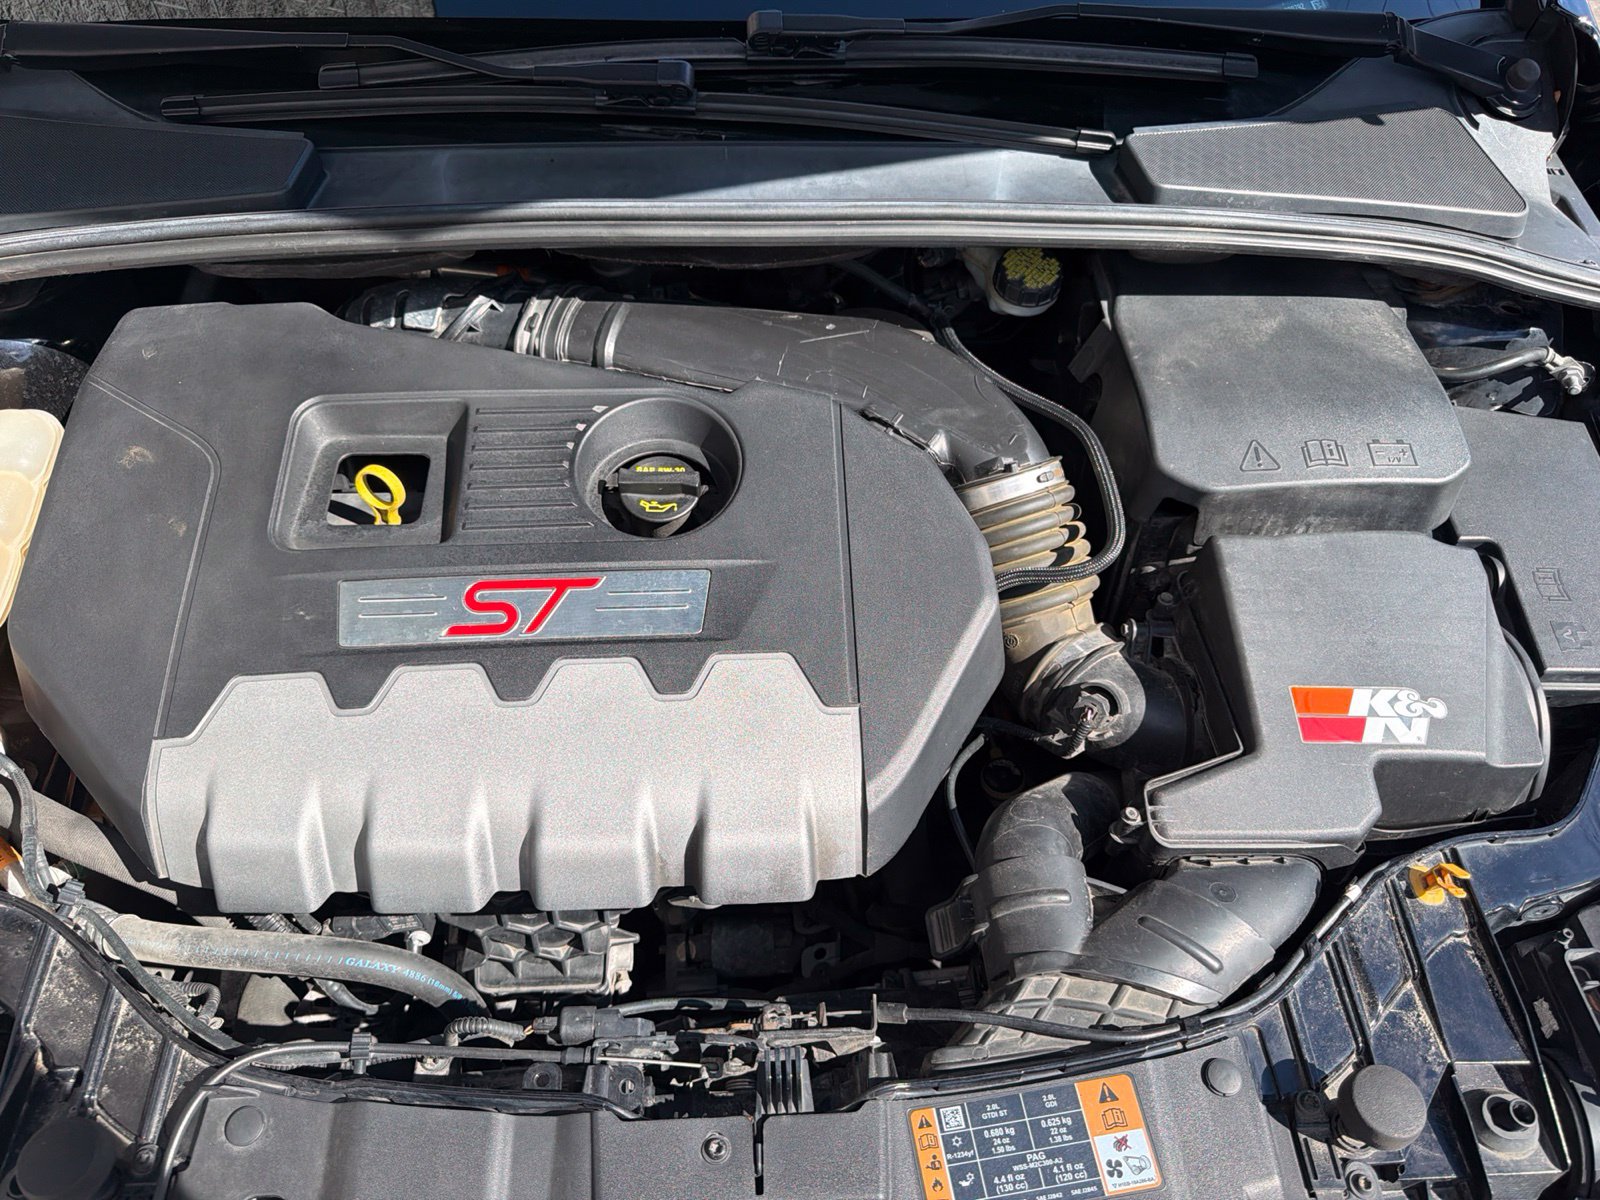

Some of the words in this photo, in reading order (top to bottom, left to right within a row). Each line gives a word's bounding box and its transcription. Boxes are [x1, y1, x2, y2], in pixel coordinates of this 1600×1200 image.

[439, 575, 606, 638] ST
[345, 956, 401, 974] GALAXY
[402, 968, 427, 982] 4886
[1044, 1101, 1058, 1109] GDI
[981, 1111, 999, 1120] GTDI
[999, 1109, 1008, 1117] ST
[1040, 1117, 1061, 1129] 0.625
[1061, 1116, 1072, 1127] kg
[1004, 1126, 1015, 1137] kg
[1050, 1128, 1059, 1136] 22
[1062, 1133, 1073, 1142] lbs
[1005, 1144, 1016, 1152] lbs
[946, 1149, 975, 1161] R-1234yf
[1026, 1151, 1047, 1162] PAG
[1053, 1165, 1065, 1174] 4.1
[1074, 1162, 1085, 1170] oz
[993, 1176, 1006, 1185] 4.4
[1015, 1173, 1026, 1181] oz
[1055, 1172, 1073, 1185] (120
[1074, 1170, 1088, 1180] cc)
[996, 1183, 1014, 1195] (130
[1015, 1181, 1029, 1191] cc)
